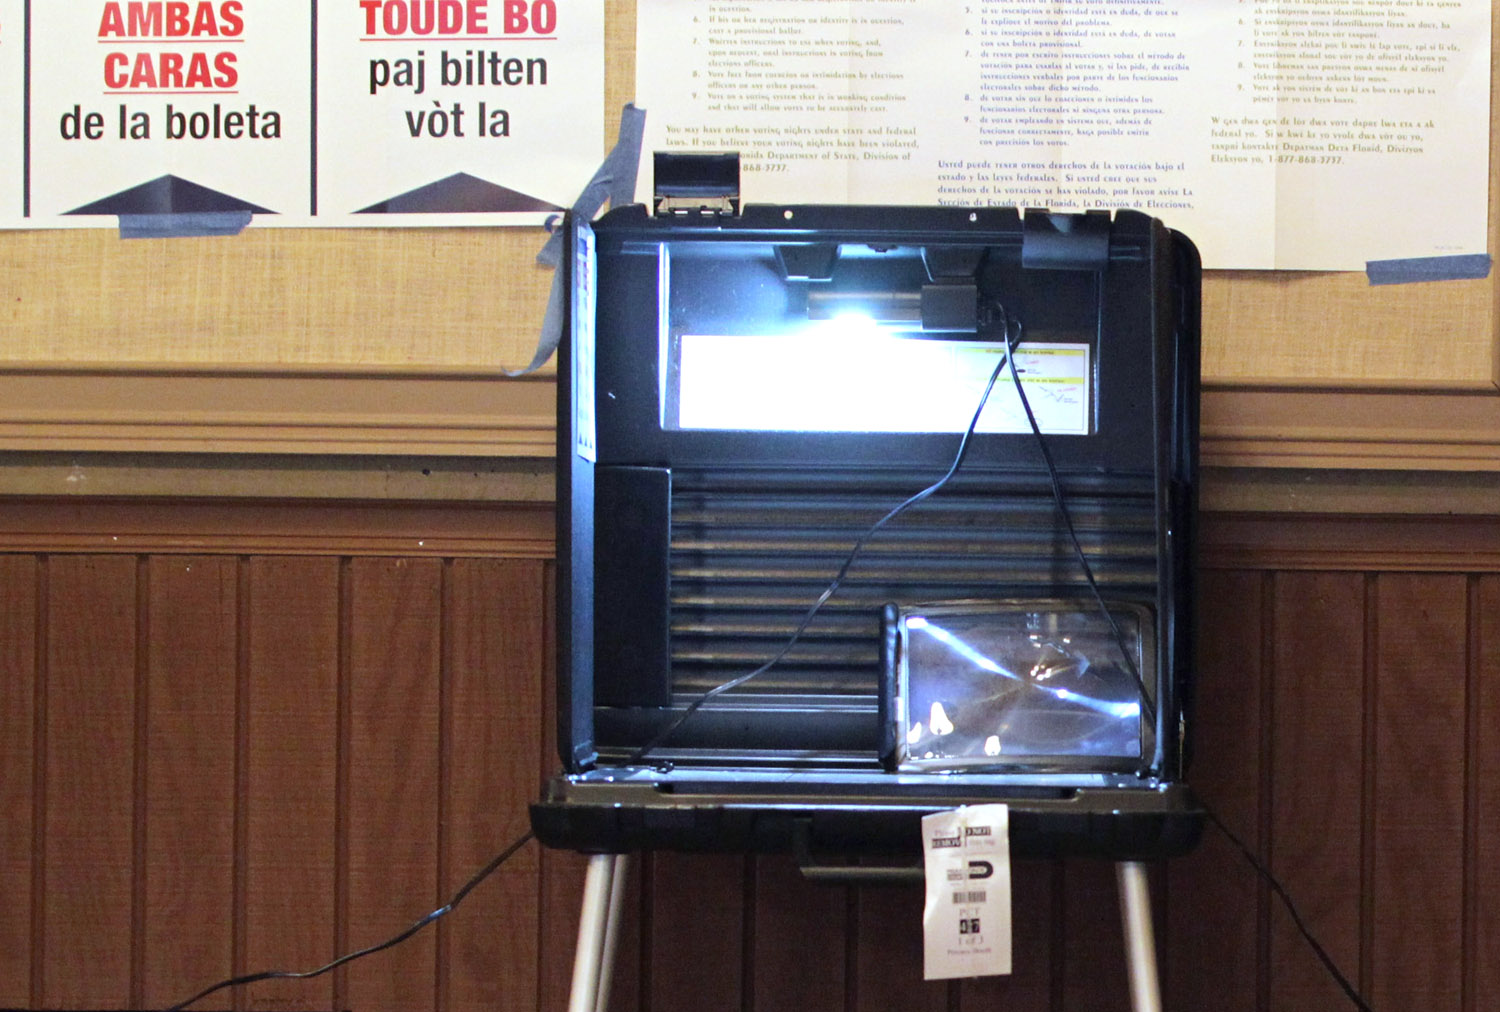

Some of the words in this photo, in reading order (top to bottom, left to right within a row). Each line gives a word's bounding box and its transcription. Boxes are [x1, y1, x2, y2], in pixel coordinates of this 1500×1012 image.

[98, 0, 244, 37] AMBAS
[360, 0, 488, 35] TOUDE
[503, 0, 557, 35] BO
[103, 51, 239, 89] CARAS
[369, 51, 426, 95] paj
[440, 49, 548, 87] bilten
[59, 104, 104, 140] de
[119, 104, 152, 140] la
[165, 104, 282, 140] boleta
[404, 100, 465, 139] vòt
[477, 101, 511, 138] la
